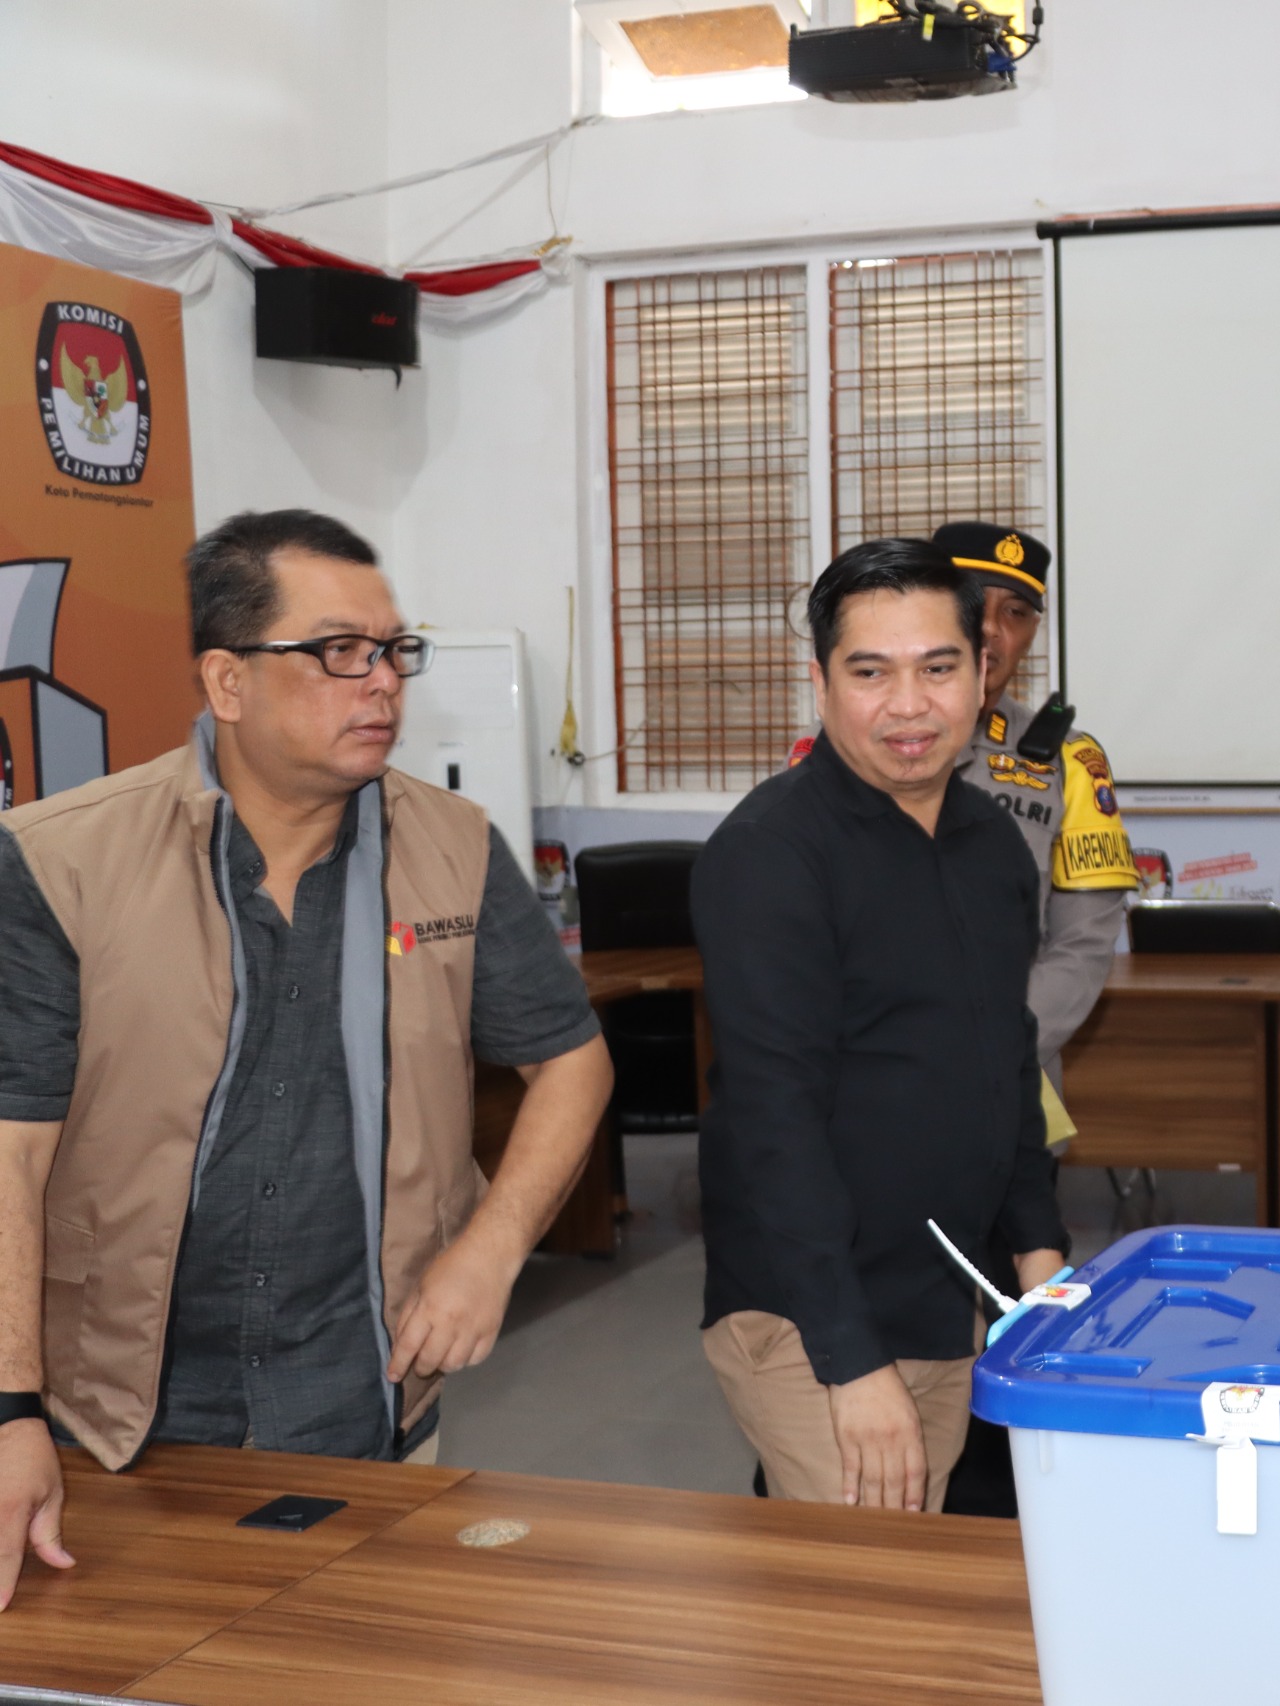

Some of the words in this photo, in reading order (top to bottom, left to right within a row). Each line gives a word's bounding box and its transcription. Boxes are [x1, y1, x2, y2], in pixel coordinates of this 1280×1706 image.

[56, 303, 124, 335] KOMISI
[40, 396, 121, 483] PEMILIHAN
[125, 413, 150, 482] UMUM
[993, 792, 1052, 826] OLRI
[414, 914, 475, 936] BAWASLU
